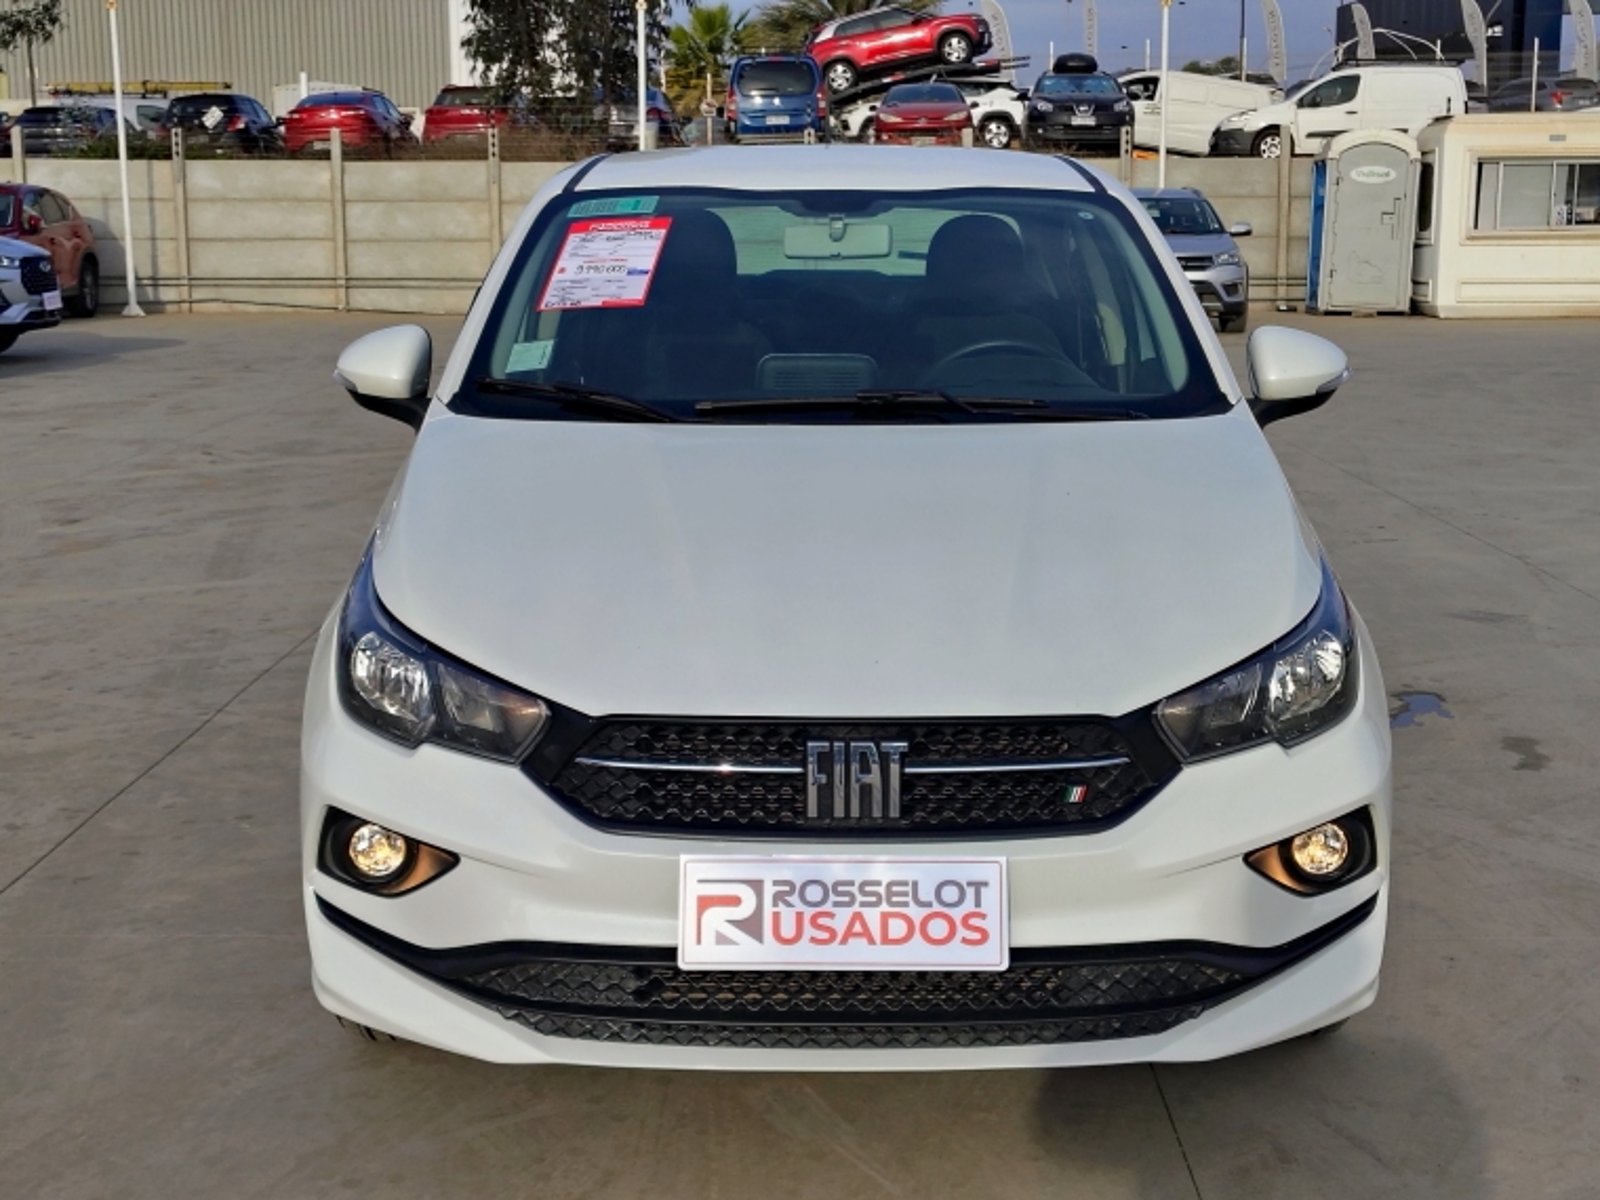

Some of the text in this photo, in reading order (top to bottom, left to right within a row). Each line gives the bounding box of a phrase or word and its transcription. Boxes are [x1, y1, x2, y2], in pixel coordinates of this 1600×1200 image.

[807, 742, 908, 818] FIAT
[772, 879, 990, 908] ROSSELOT
[771, 910, 991, 946] USADOS
